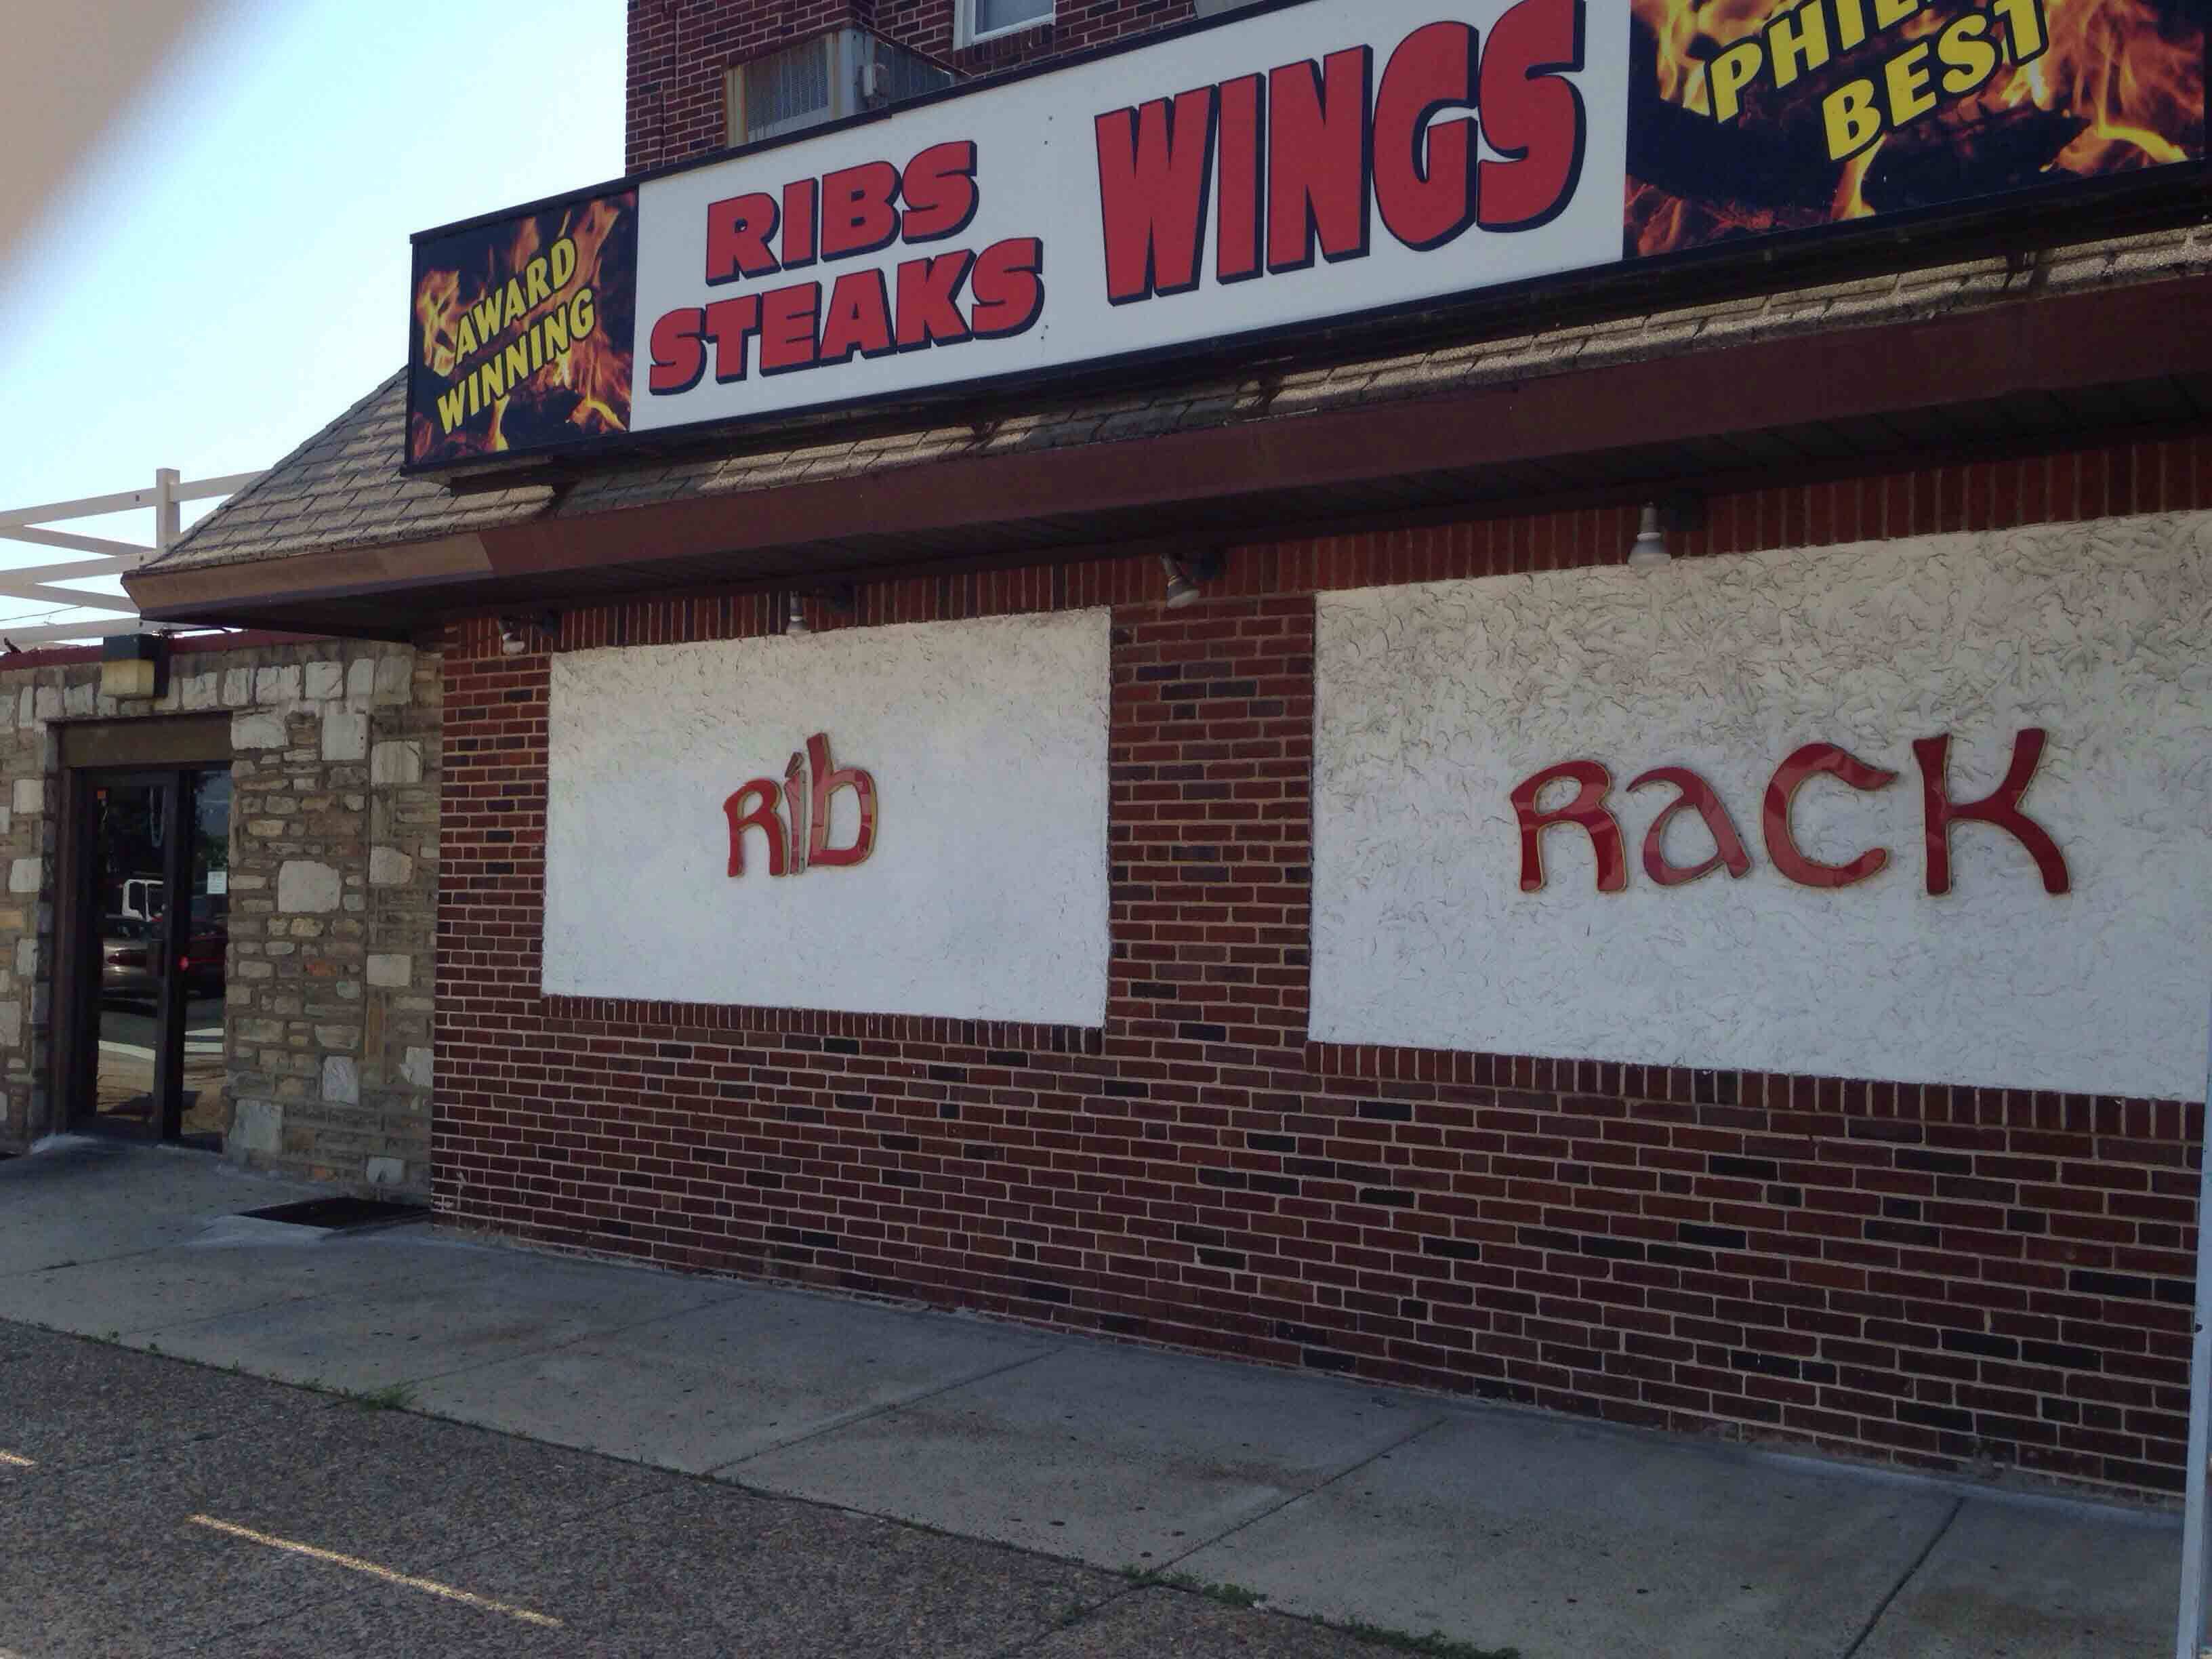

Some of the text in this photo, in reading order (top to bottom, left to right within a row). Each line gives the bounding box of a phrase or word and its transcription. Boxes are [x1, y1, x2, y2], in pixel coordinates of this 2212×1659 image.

[1094, 0, 1587, 306] WINGS
[1822, 0, 2041, 161] BEST
[705, 140, 979, 287] RIBS
[437, 288, 594, 435] WINNING
[455, 238, 576, 365] AWARD
[649, 237, 1044, 396] STEAKS
